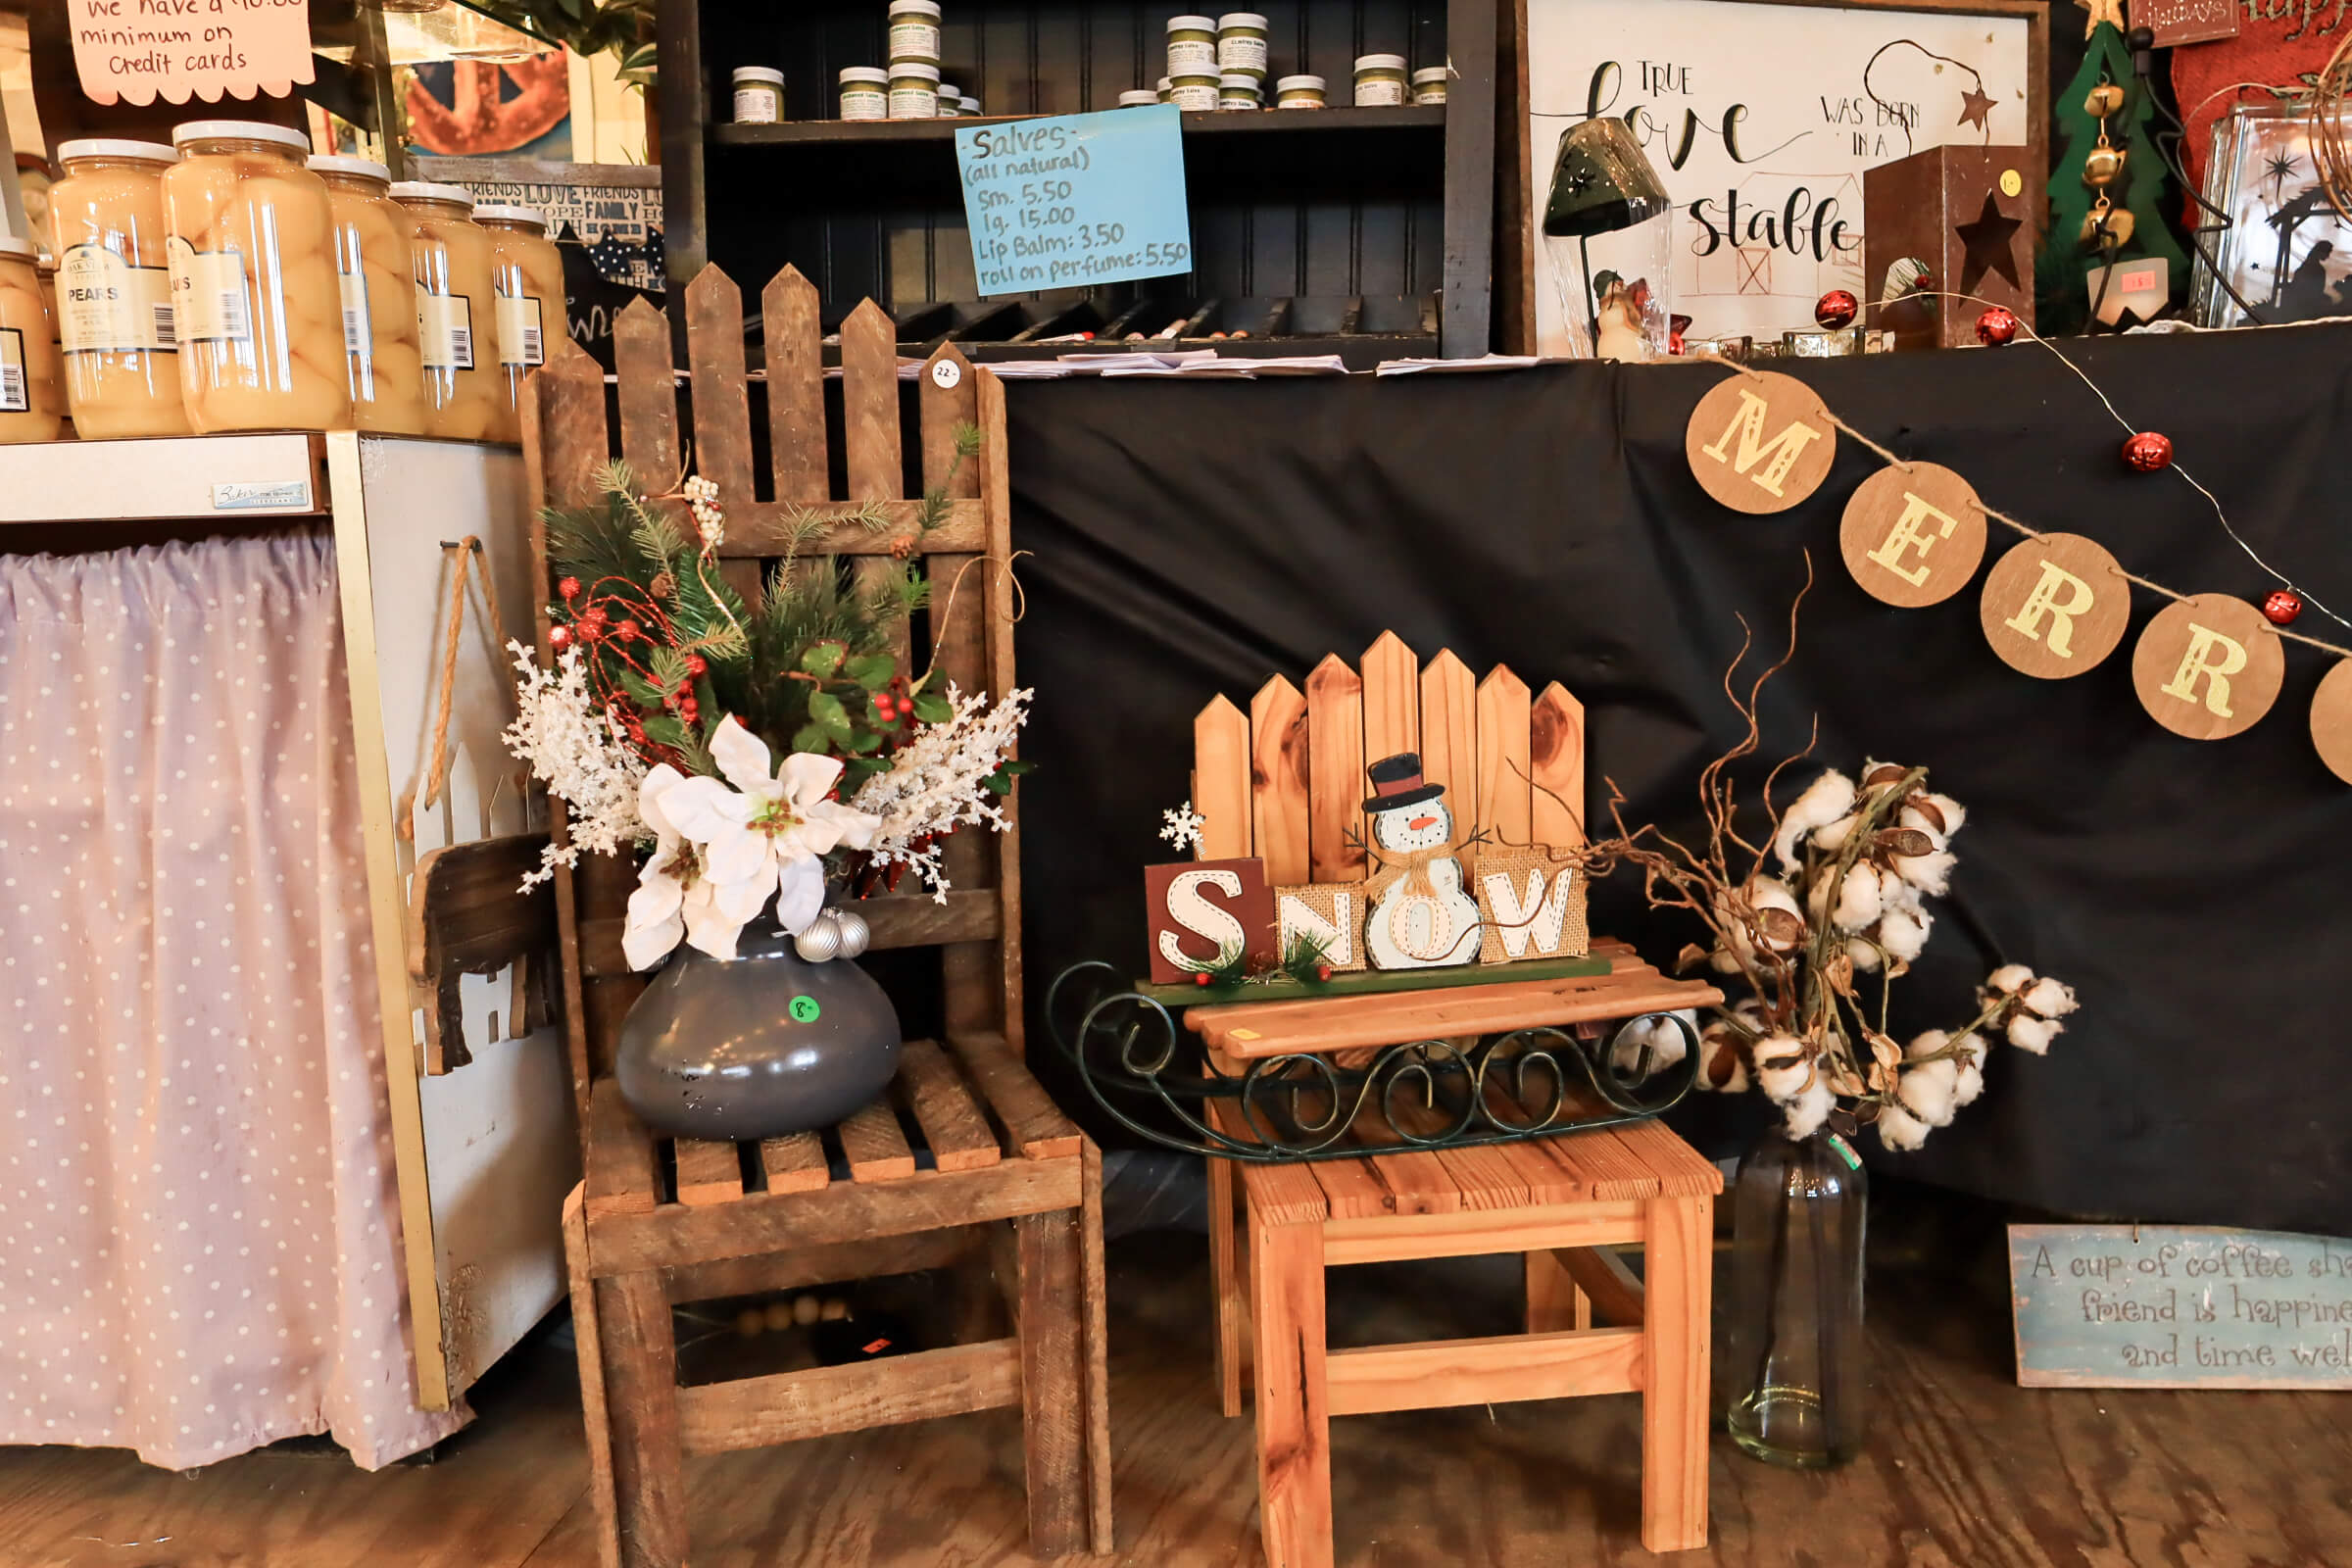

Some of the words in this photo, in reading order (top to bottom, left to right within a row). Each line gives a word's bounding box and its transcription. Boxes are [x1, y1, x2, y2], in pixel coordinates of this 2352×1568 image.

[139, 0, 199, 16] have
[209, 0, 223, 14] a
[80, 26, 192, 46] minimum
[204, 26, 233, 42] on
[185, 43, 247, 72] cards
[1637, 60, 1694, 97] TRUE
[1820, 95, 1864, 125] WAS
[1876, 102, 1921, 129] BORN
[1852, 131, 1868, 157] IN
[1875, 132, 1889, 158] A
[965, 164, 999, 187] (all
[1005, 146, 1091, 176] natural)
[524, 184, 582, 205] LOVE
[583, 186, 639, 200] FRIENDS
[1021, 180, 1073, 206] 5.50
[535, 206, 584, 219] OPE
[585, 201, 639, 220] FAMILY
[1019, 206, 1075, 229] 15.00
[1682, 187, 1864, 263] stable
[978, 238, 1008, 266] Lip
[1012, 234, 1074, 259] Balm:
[1078, 222, 1125, 250] 3.50
[981, 267, 1015, 286] roll
[1020, 266, 1044, 281] on
[1049, 251, 1142, 282] perfume:
[1146, 242, 1189, 267] 5.50
[1157, 866, 1574, 971] SNOW
[2031, 1244, 2057, 1279] A
[2070, 1254, 2124, 1283] cup
[2136, 1244, 2179, 1278] of
[2185, 1244, 2294, 1278] coffee
[2082, 1288, 2178, 1323] friend
[2191, 1292, 2218, 1323] is
[2121, 1333, 2180, 1367] and
[2195, 1335, 2277, 1367] time
